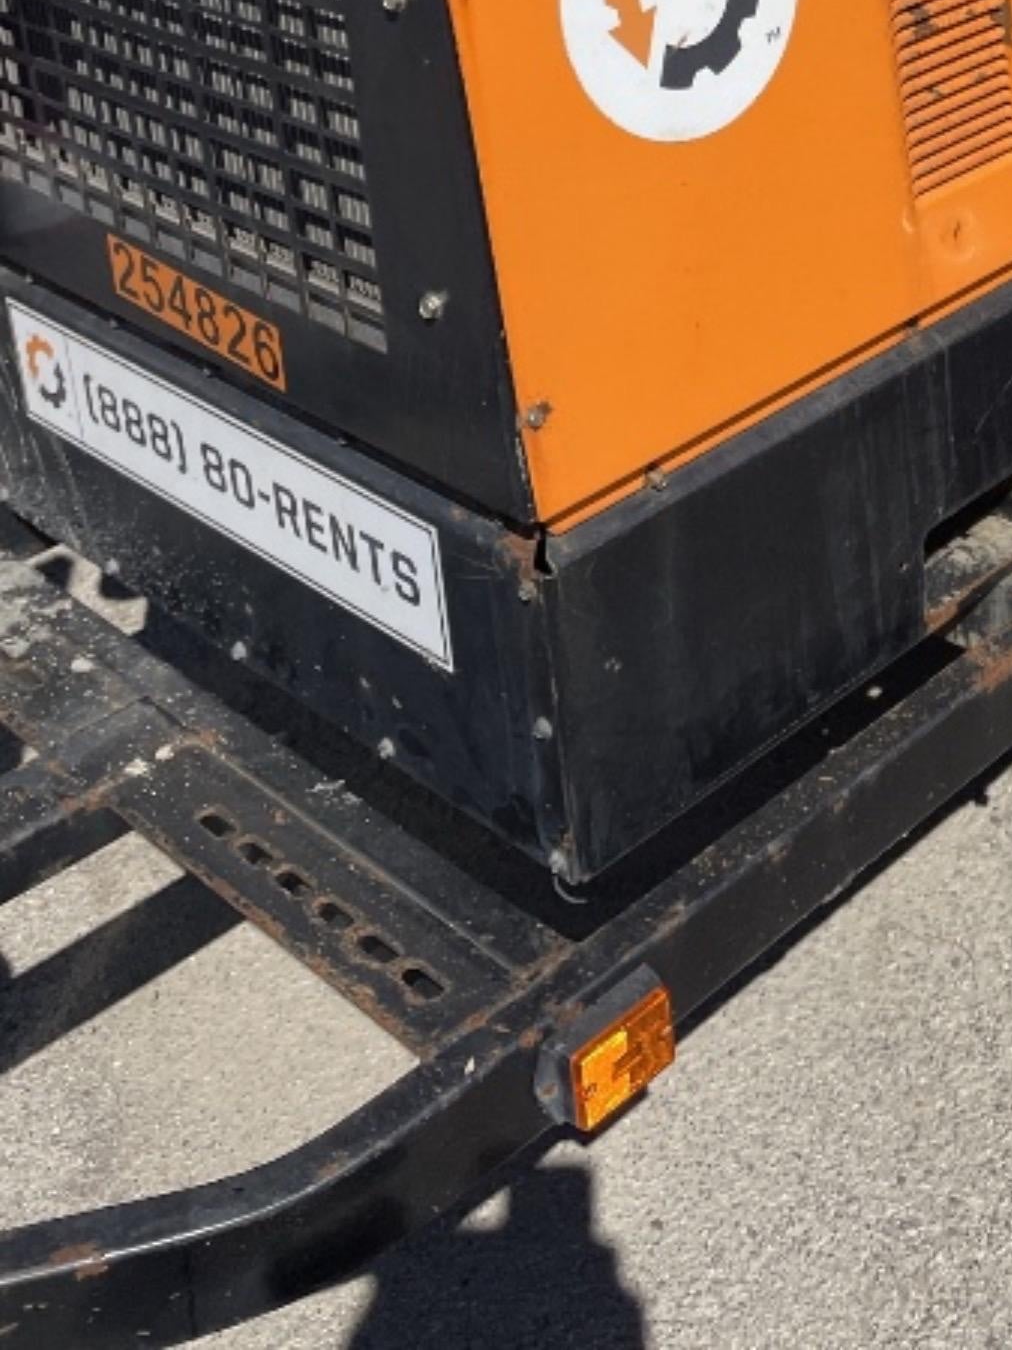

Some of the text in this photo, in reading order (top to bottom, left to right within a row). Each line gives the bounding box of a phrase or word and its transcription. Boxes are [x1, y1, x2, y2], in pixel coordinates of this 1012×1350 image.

[112, 240, 281, 382] 254826
[83, 374, 421, 607] (888) 80-RENTS
